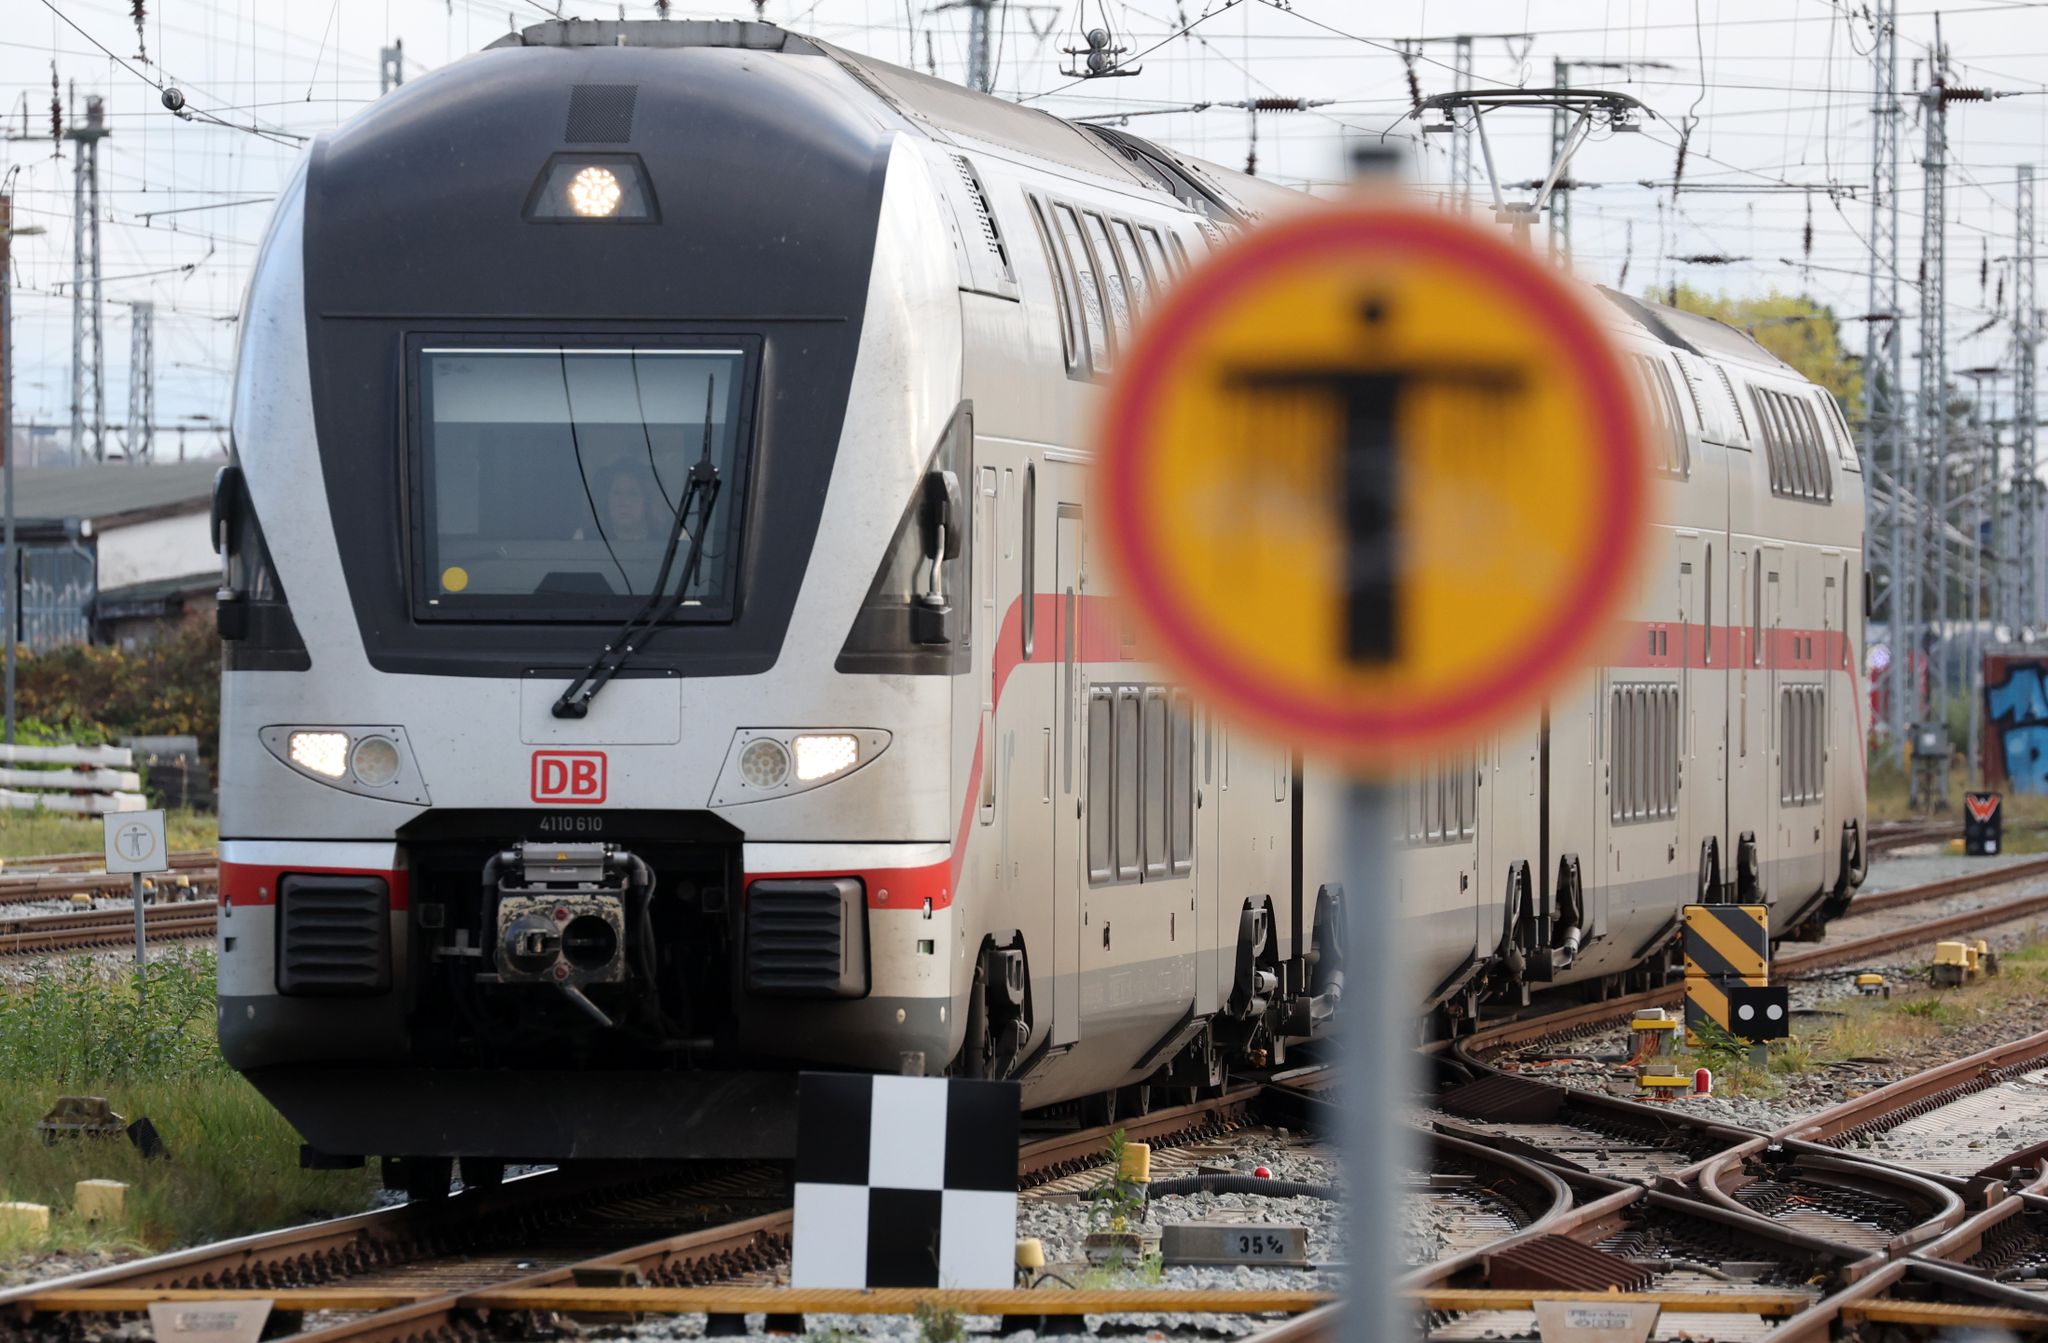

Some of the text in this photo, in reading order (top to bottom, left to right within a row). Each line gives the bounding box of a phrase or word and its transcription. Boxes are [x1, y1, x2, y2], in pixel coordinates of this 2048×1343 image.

[541, 759, 598, 795] DB
[540, 816, 603, 831] 4110 610
